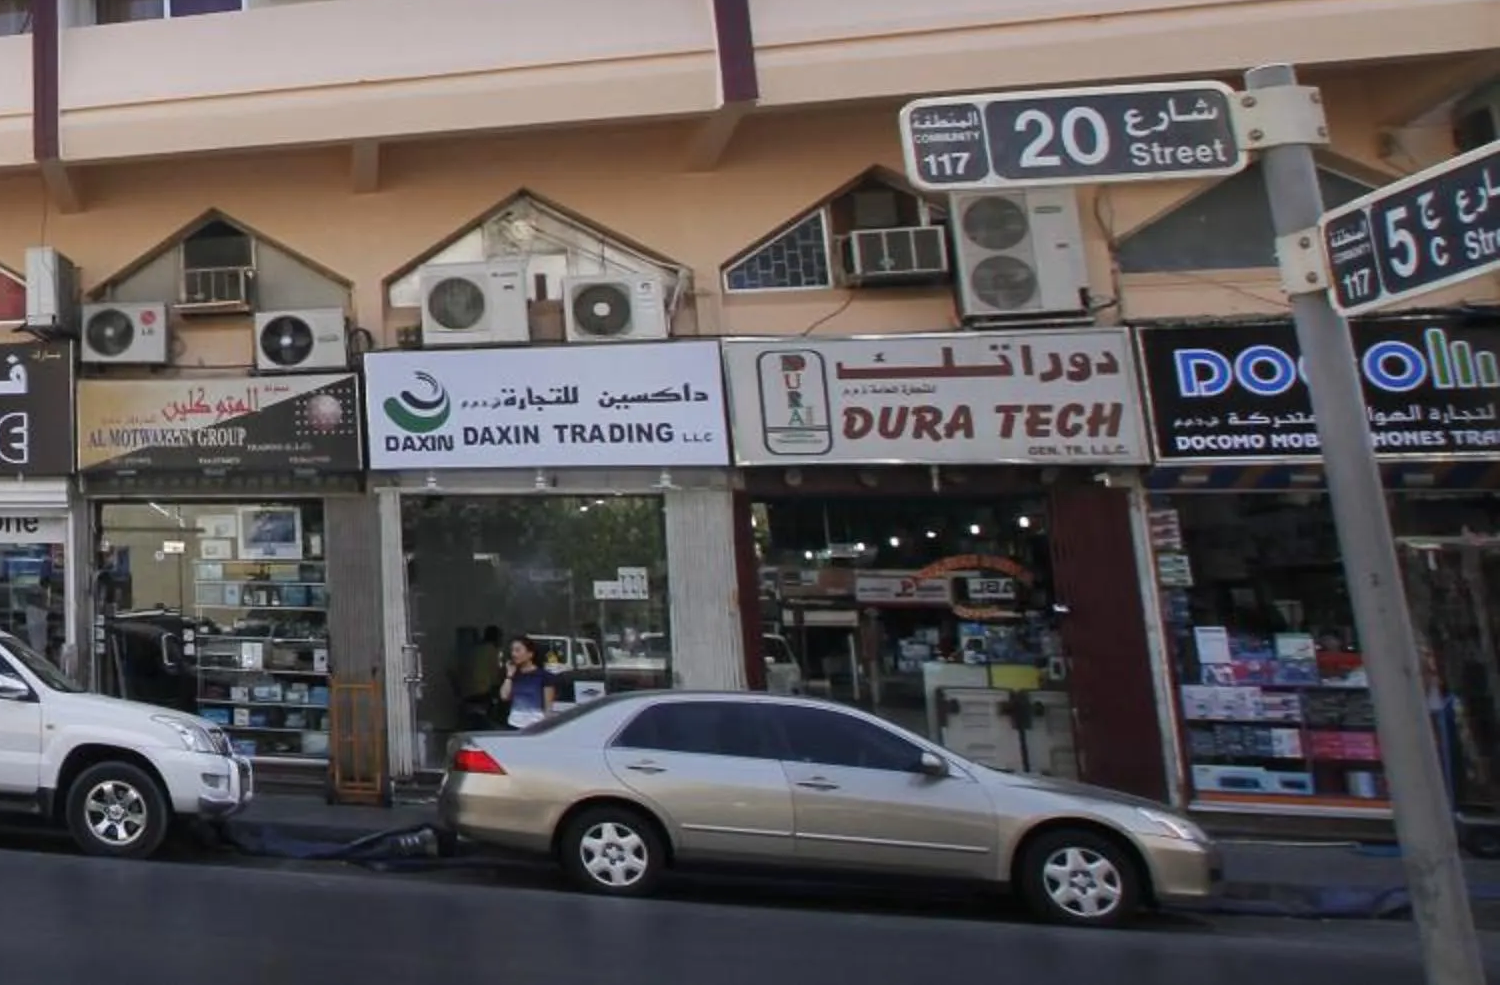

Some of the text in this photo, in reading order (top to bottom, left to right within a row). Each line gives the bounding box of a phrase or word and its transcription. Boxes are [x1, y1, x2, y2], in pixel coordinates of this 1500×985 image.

[912, 110, 980, 129] المنطقة
[1123, 98, 1219, 137] شارع
[914, 130, 981, 144] COMMUNITY
[1014, 107, 1110, 168] 20
[923, 152, 971, 176] 117
[1129, 138, 1228, 166] Street
[1455, 168, 1500, 224] ارع
[1416, 190, 1442, 230] ج
[1384, 206, 1418, 278] 5
[1429, 236, 1450, 266] C
[1342, 267, 1372, 300] 117
[500, 385, 579, 412] للتجارة
[598, 383, 708, 409] داكسين
[780, 354, 806, 426] DURA
[843, 406, 975, 442] DURA
[995, 402, 1123, 439] TECH
[1366, 403, 1422, 426] الهوا
[88, 428, 106, 448] AL
[196, 426, 247, 447] GROUP
[385, 435, 453, 452] DAXIN
[463, 425, 539, 445] DAXIN
[553, 422, 675, 445] TRADING
[1175, 430, 1500, 450] DOCOMO MOB HONES TRA
